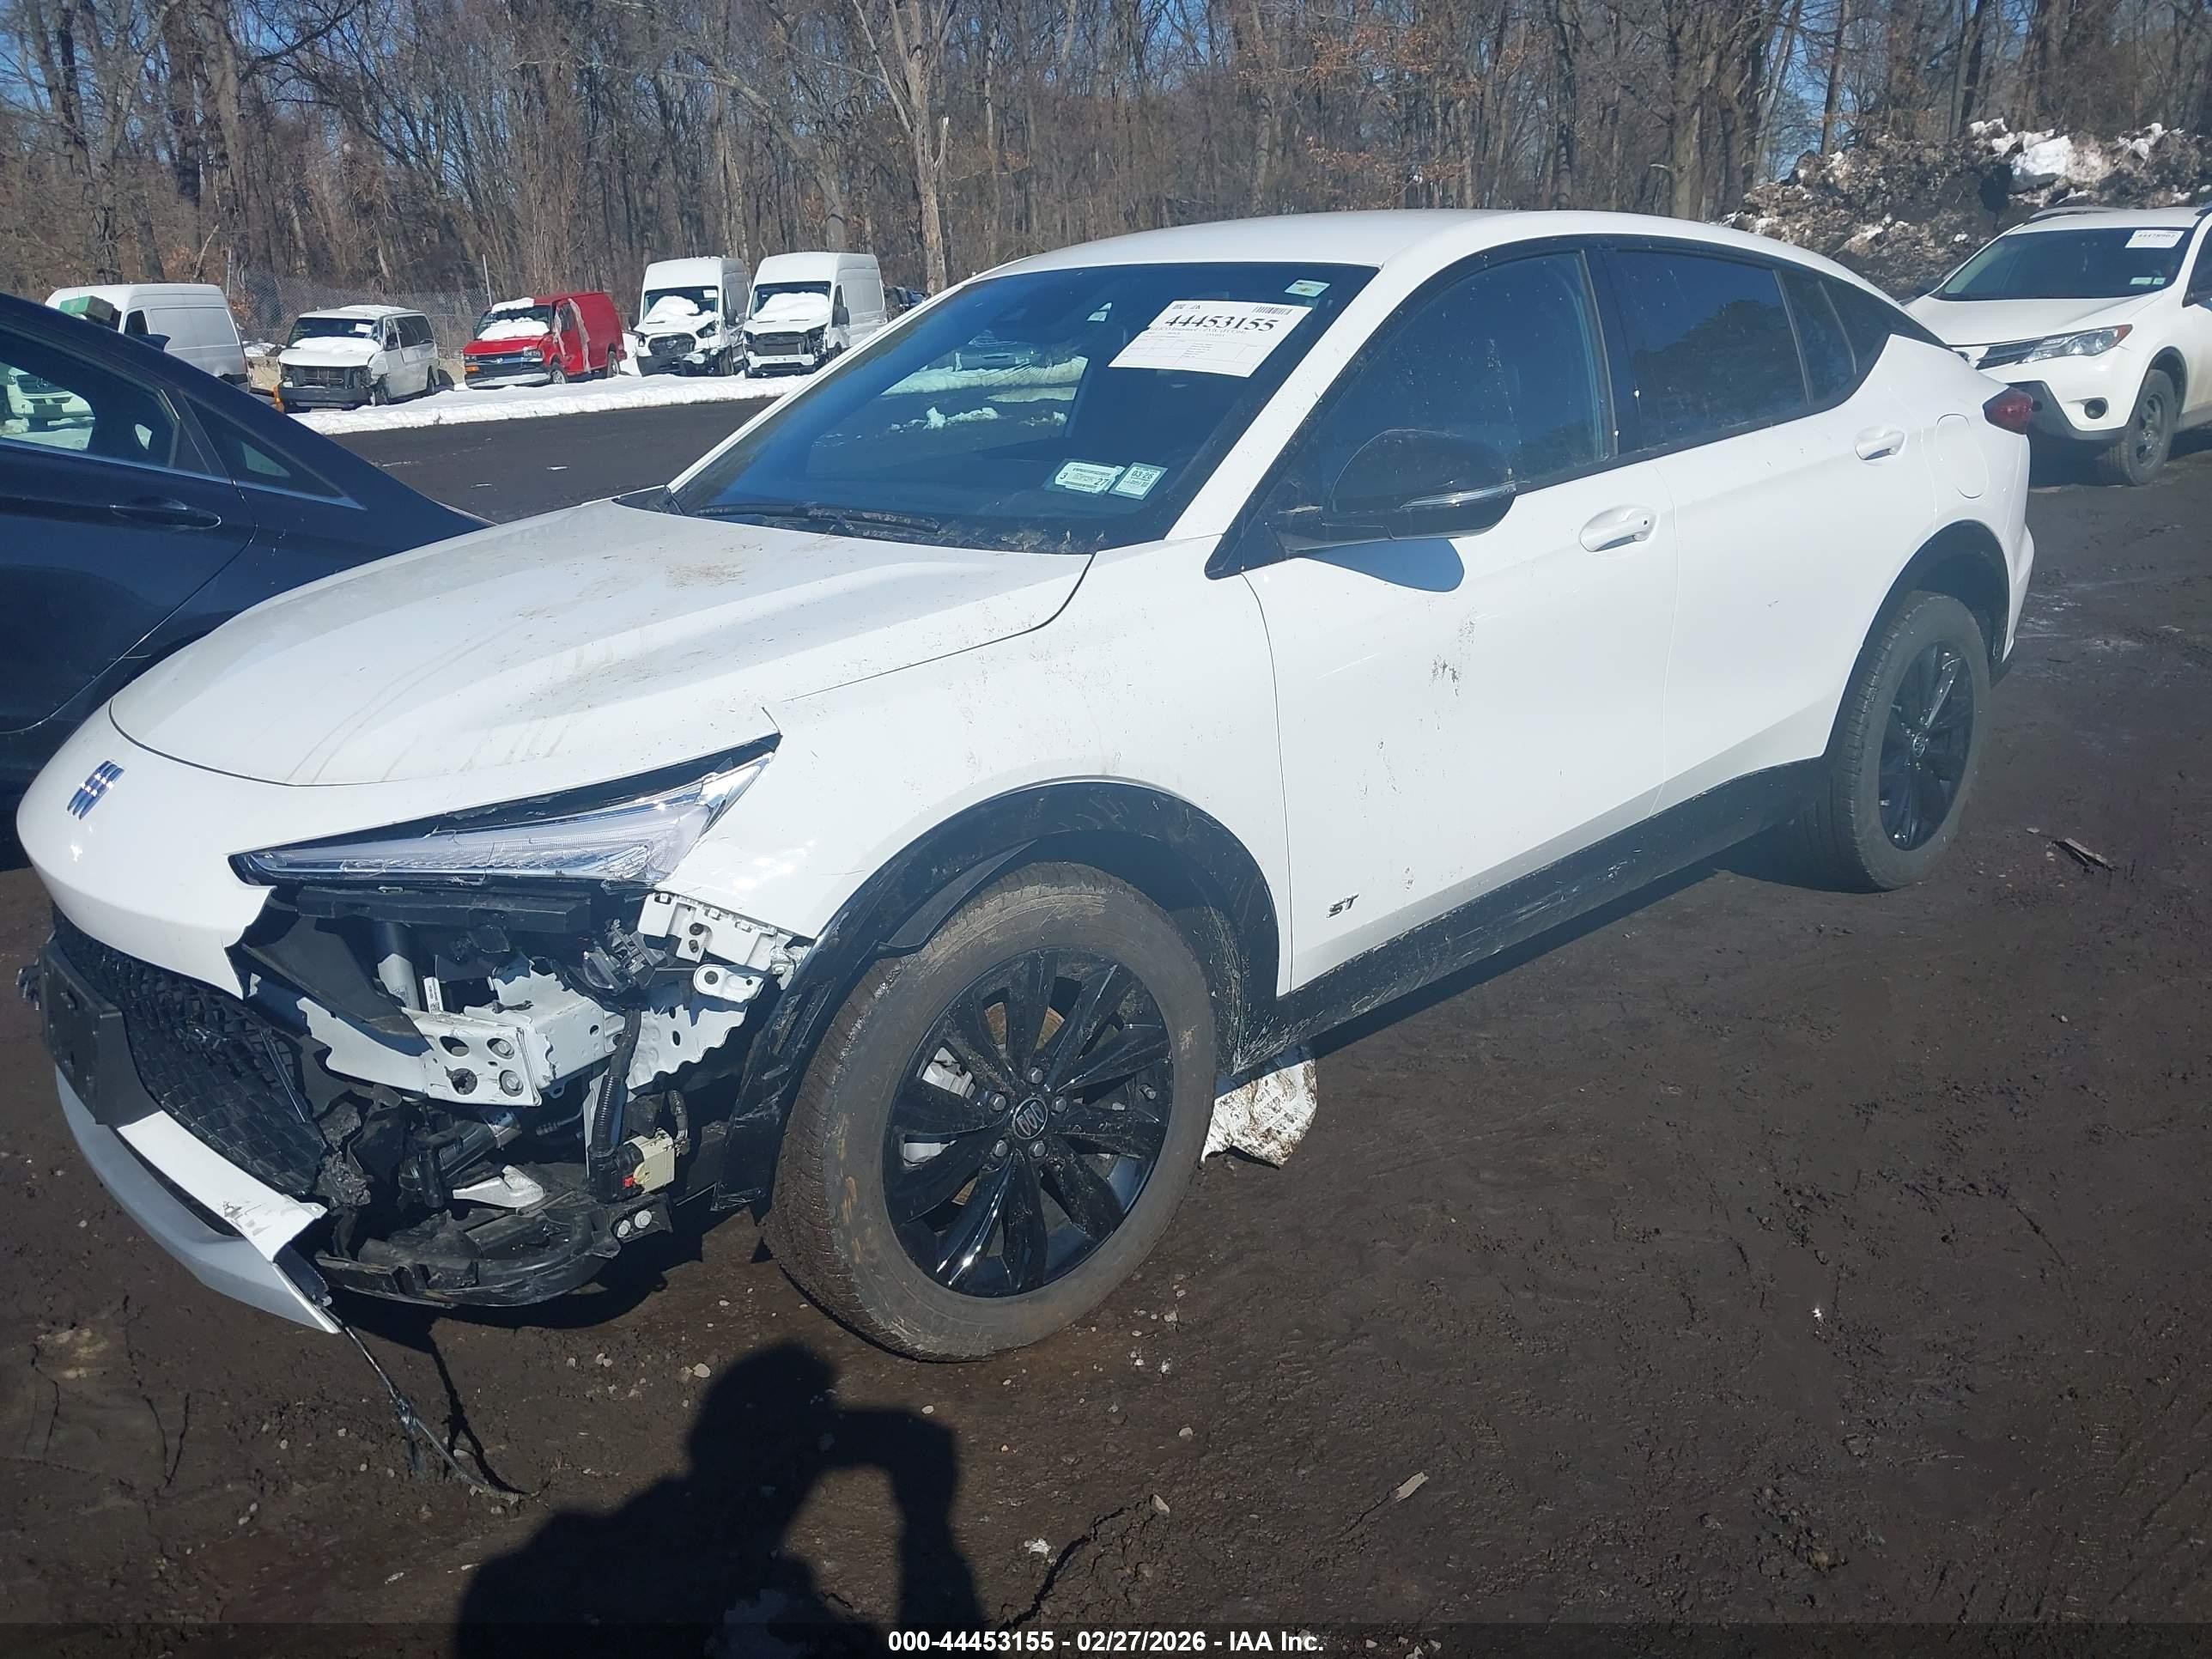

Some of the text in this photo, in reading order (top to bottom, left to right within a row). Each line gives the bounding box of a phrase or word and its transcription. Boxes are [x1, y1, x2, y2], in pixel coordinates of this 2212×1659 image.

[1164, 314, 1279, 331] 44453155
[1060, 471, 1068, 480] 3
[1094, 477, 1109, 486] 27
[1327, 893, 1359, 918] ST
